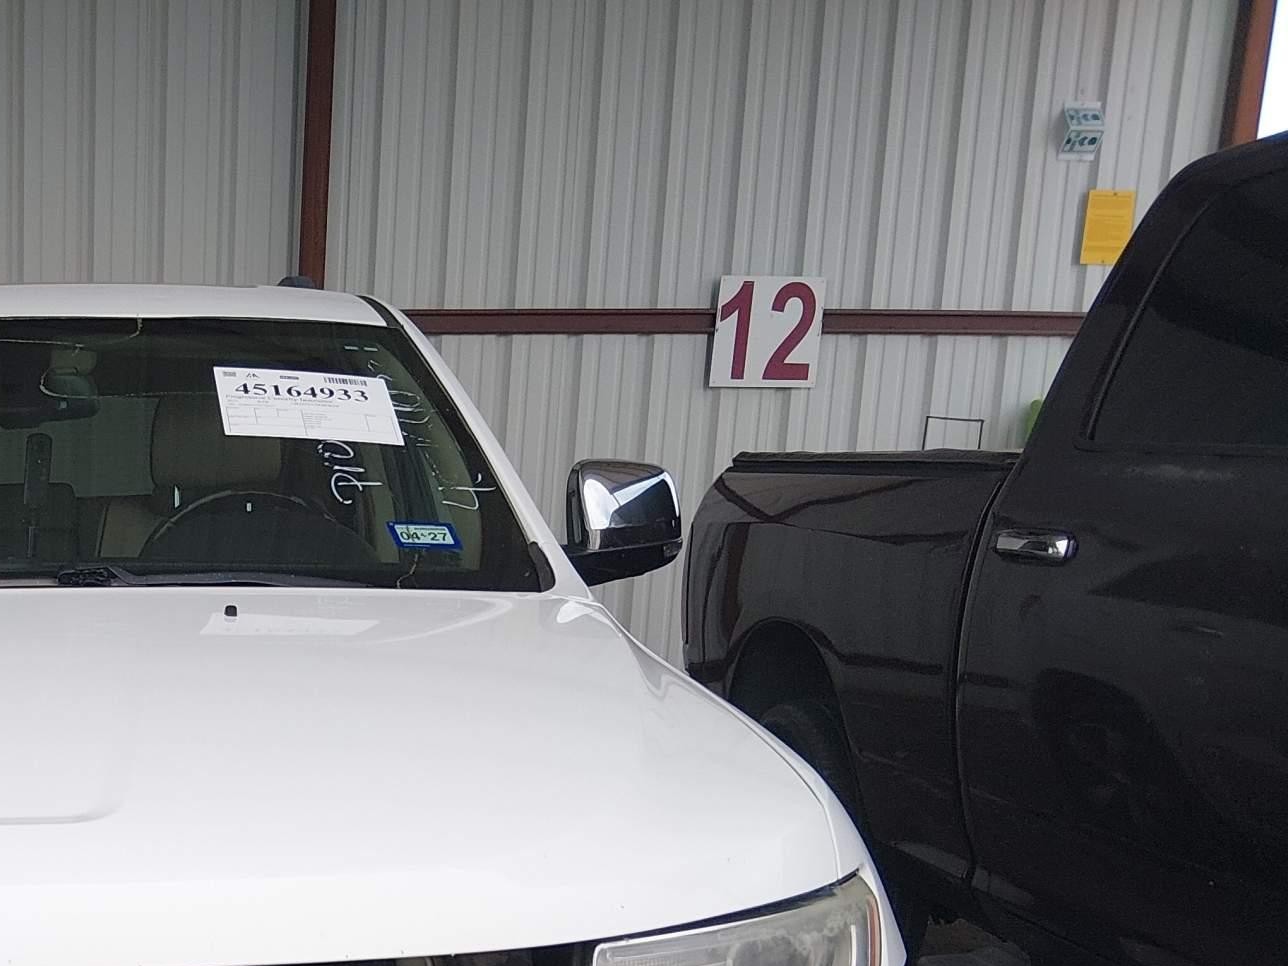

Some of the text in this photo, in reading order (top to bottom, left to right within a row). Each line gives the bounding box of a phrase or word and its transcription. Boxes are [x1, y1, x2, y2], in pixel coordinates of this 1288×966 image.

[719, 280, 817, 381] 12
[235, 382, 369, 402] 45164933
[399, 530, 447, 542] 04 27
